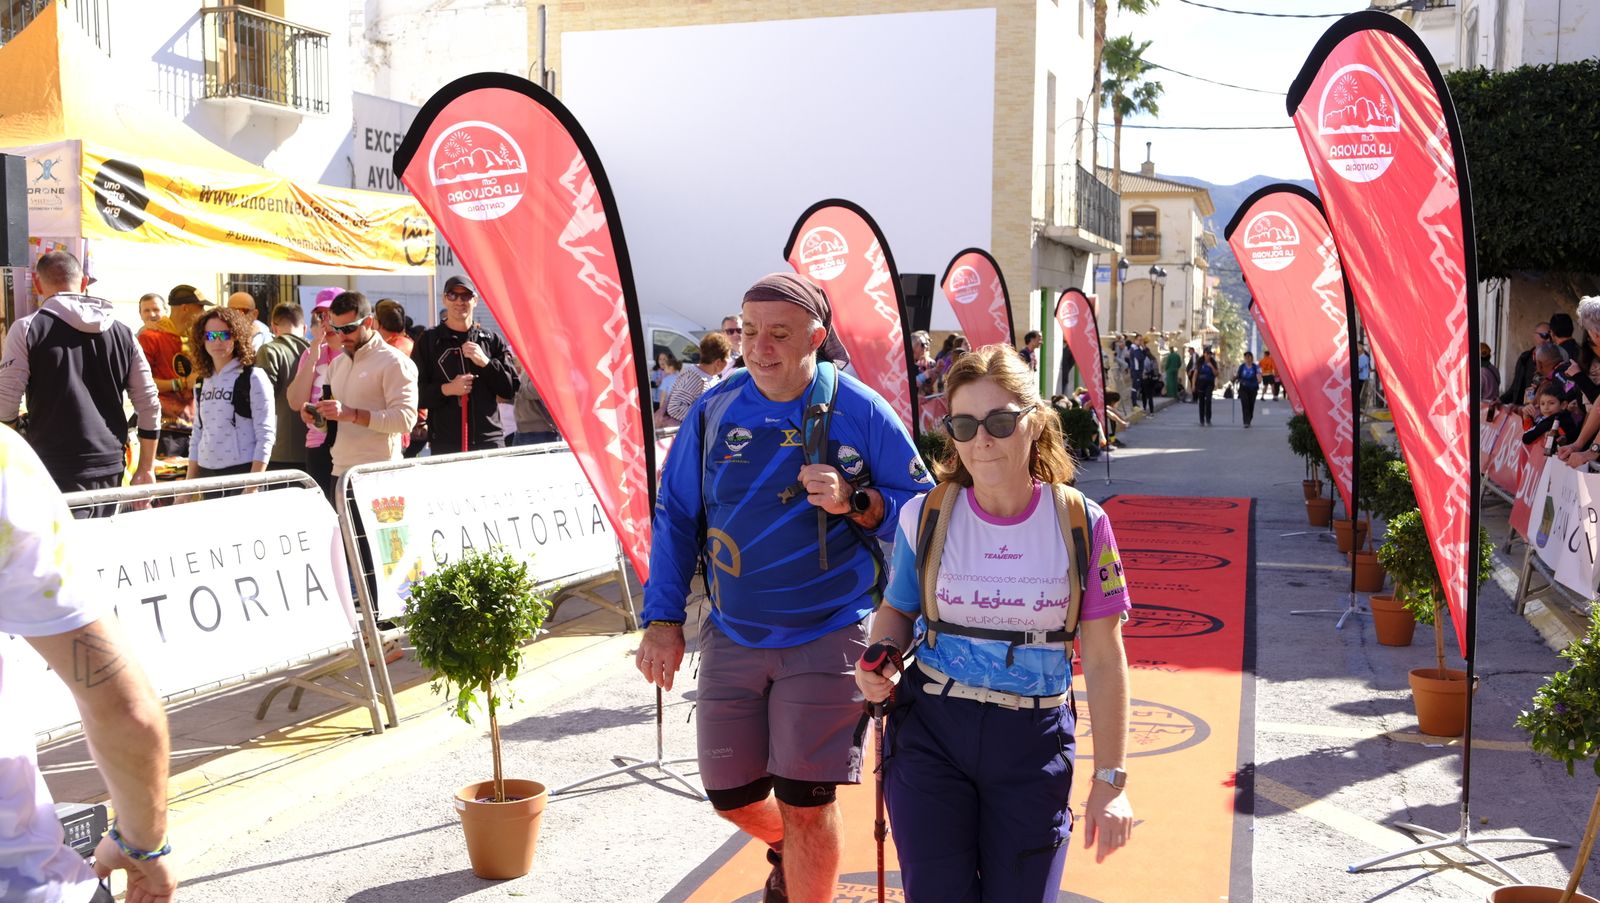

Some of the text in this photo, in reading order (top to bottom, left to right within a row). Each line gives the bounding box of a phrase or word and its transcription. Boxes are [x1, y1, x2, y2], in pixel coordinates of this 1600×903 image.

[365, 127, 402, 153] EXCE
[103, 181, 120, 191] uno
[279, 530, 311, 556] DE
[431, 503, 606, 566] CANTORIA
[113, 563, 329, 644] TORIA
[966, 616, 1035, 626] PURCHENA
